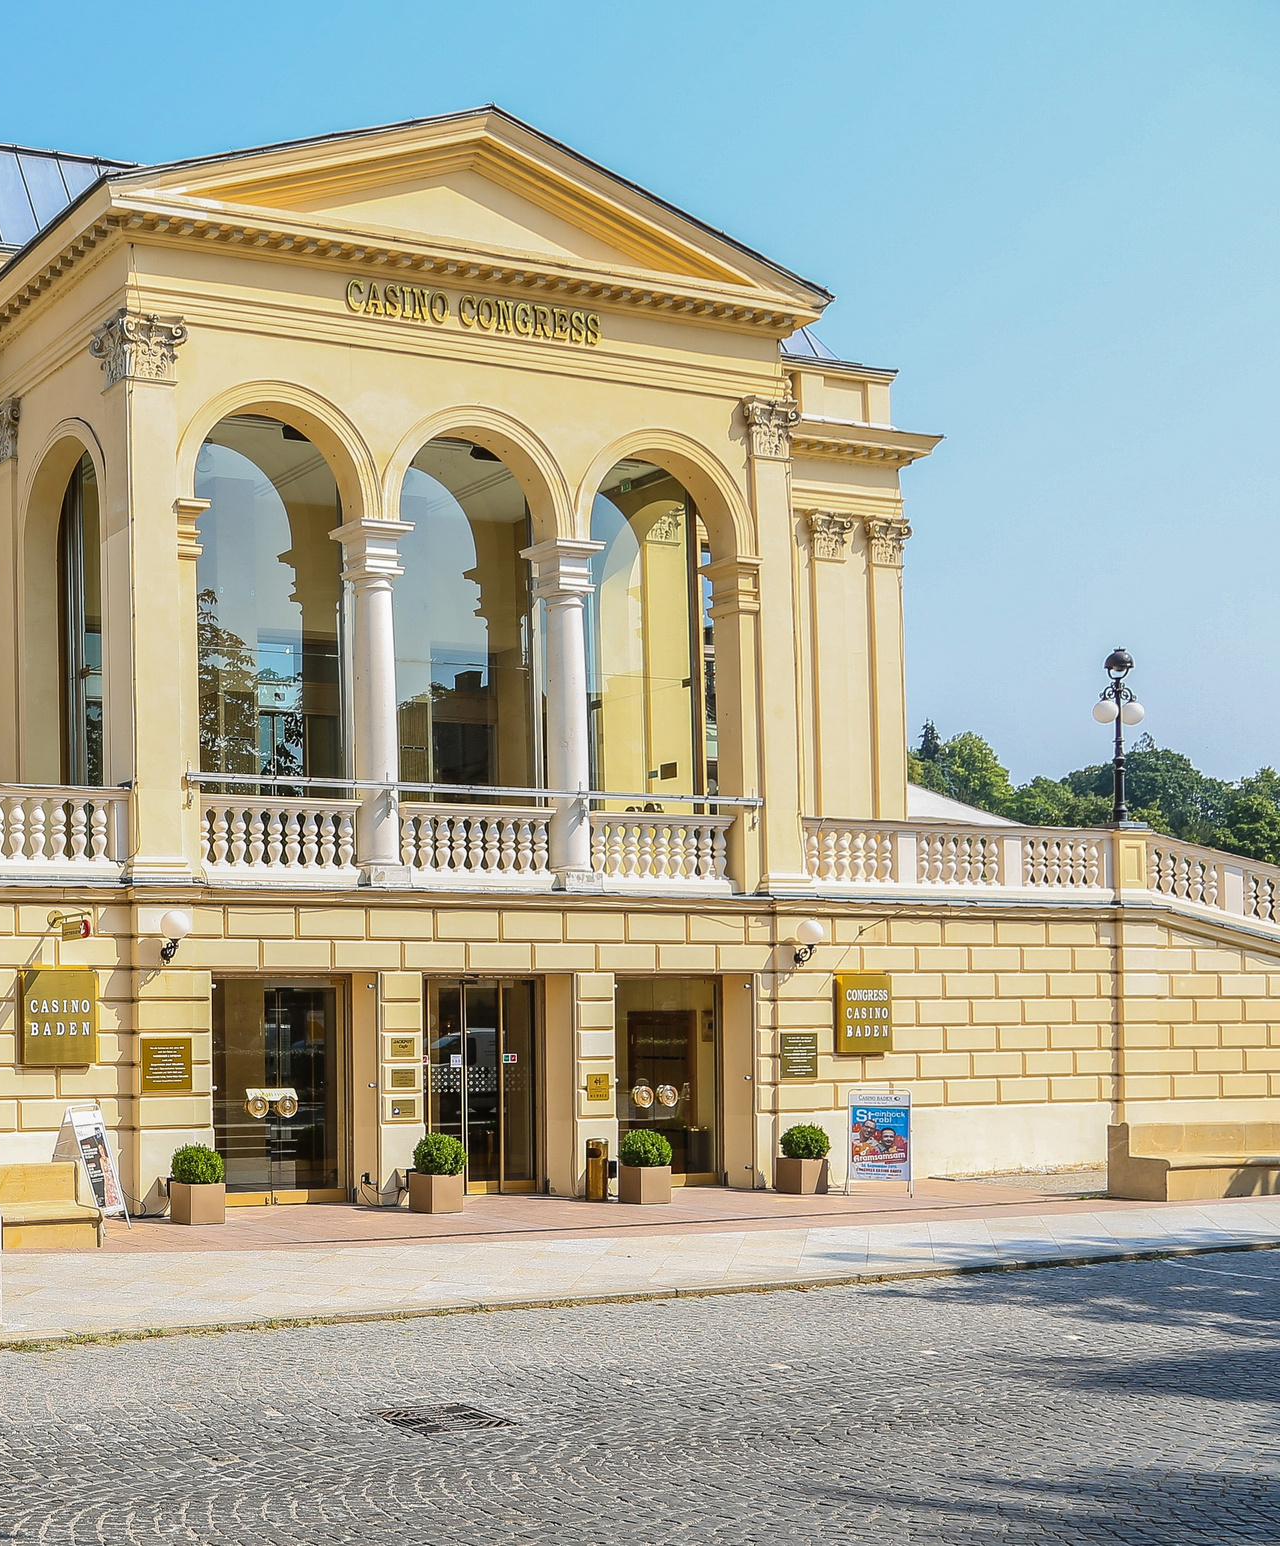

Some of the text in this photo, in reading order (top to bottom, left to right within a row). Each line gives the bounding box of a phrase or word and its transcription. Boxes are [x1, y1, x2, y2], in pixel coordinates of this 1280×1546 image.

[346, 279, 603, 345] CASINO CONGRESS
[846, 988, 889, 1002] CONGRESS
[29, 999, 92, 1014] CASINO
[846, 1007, 889, 1020] CASINO
[29, 1021, 92, 1036] BADEN
[846, 1025, 889, 1038] BADEN
